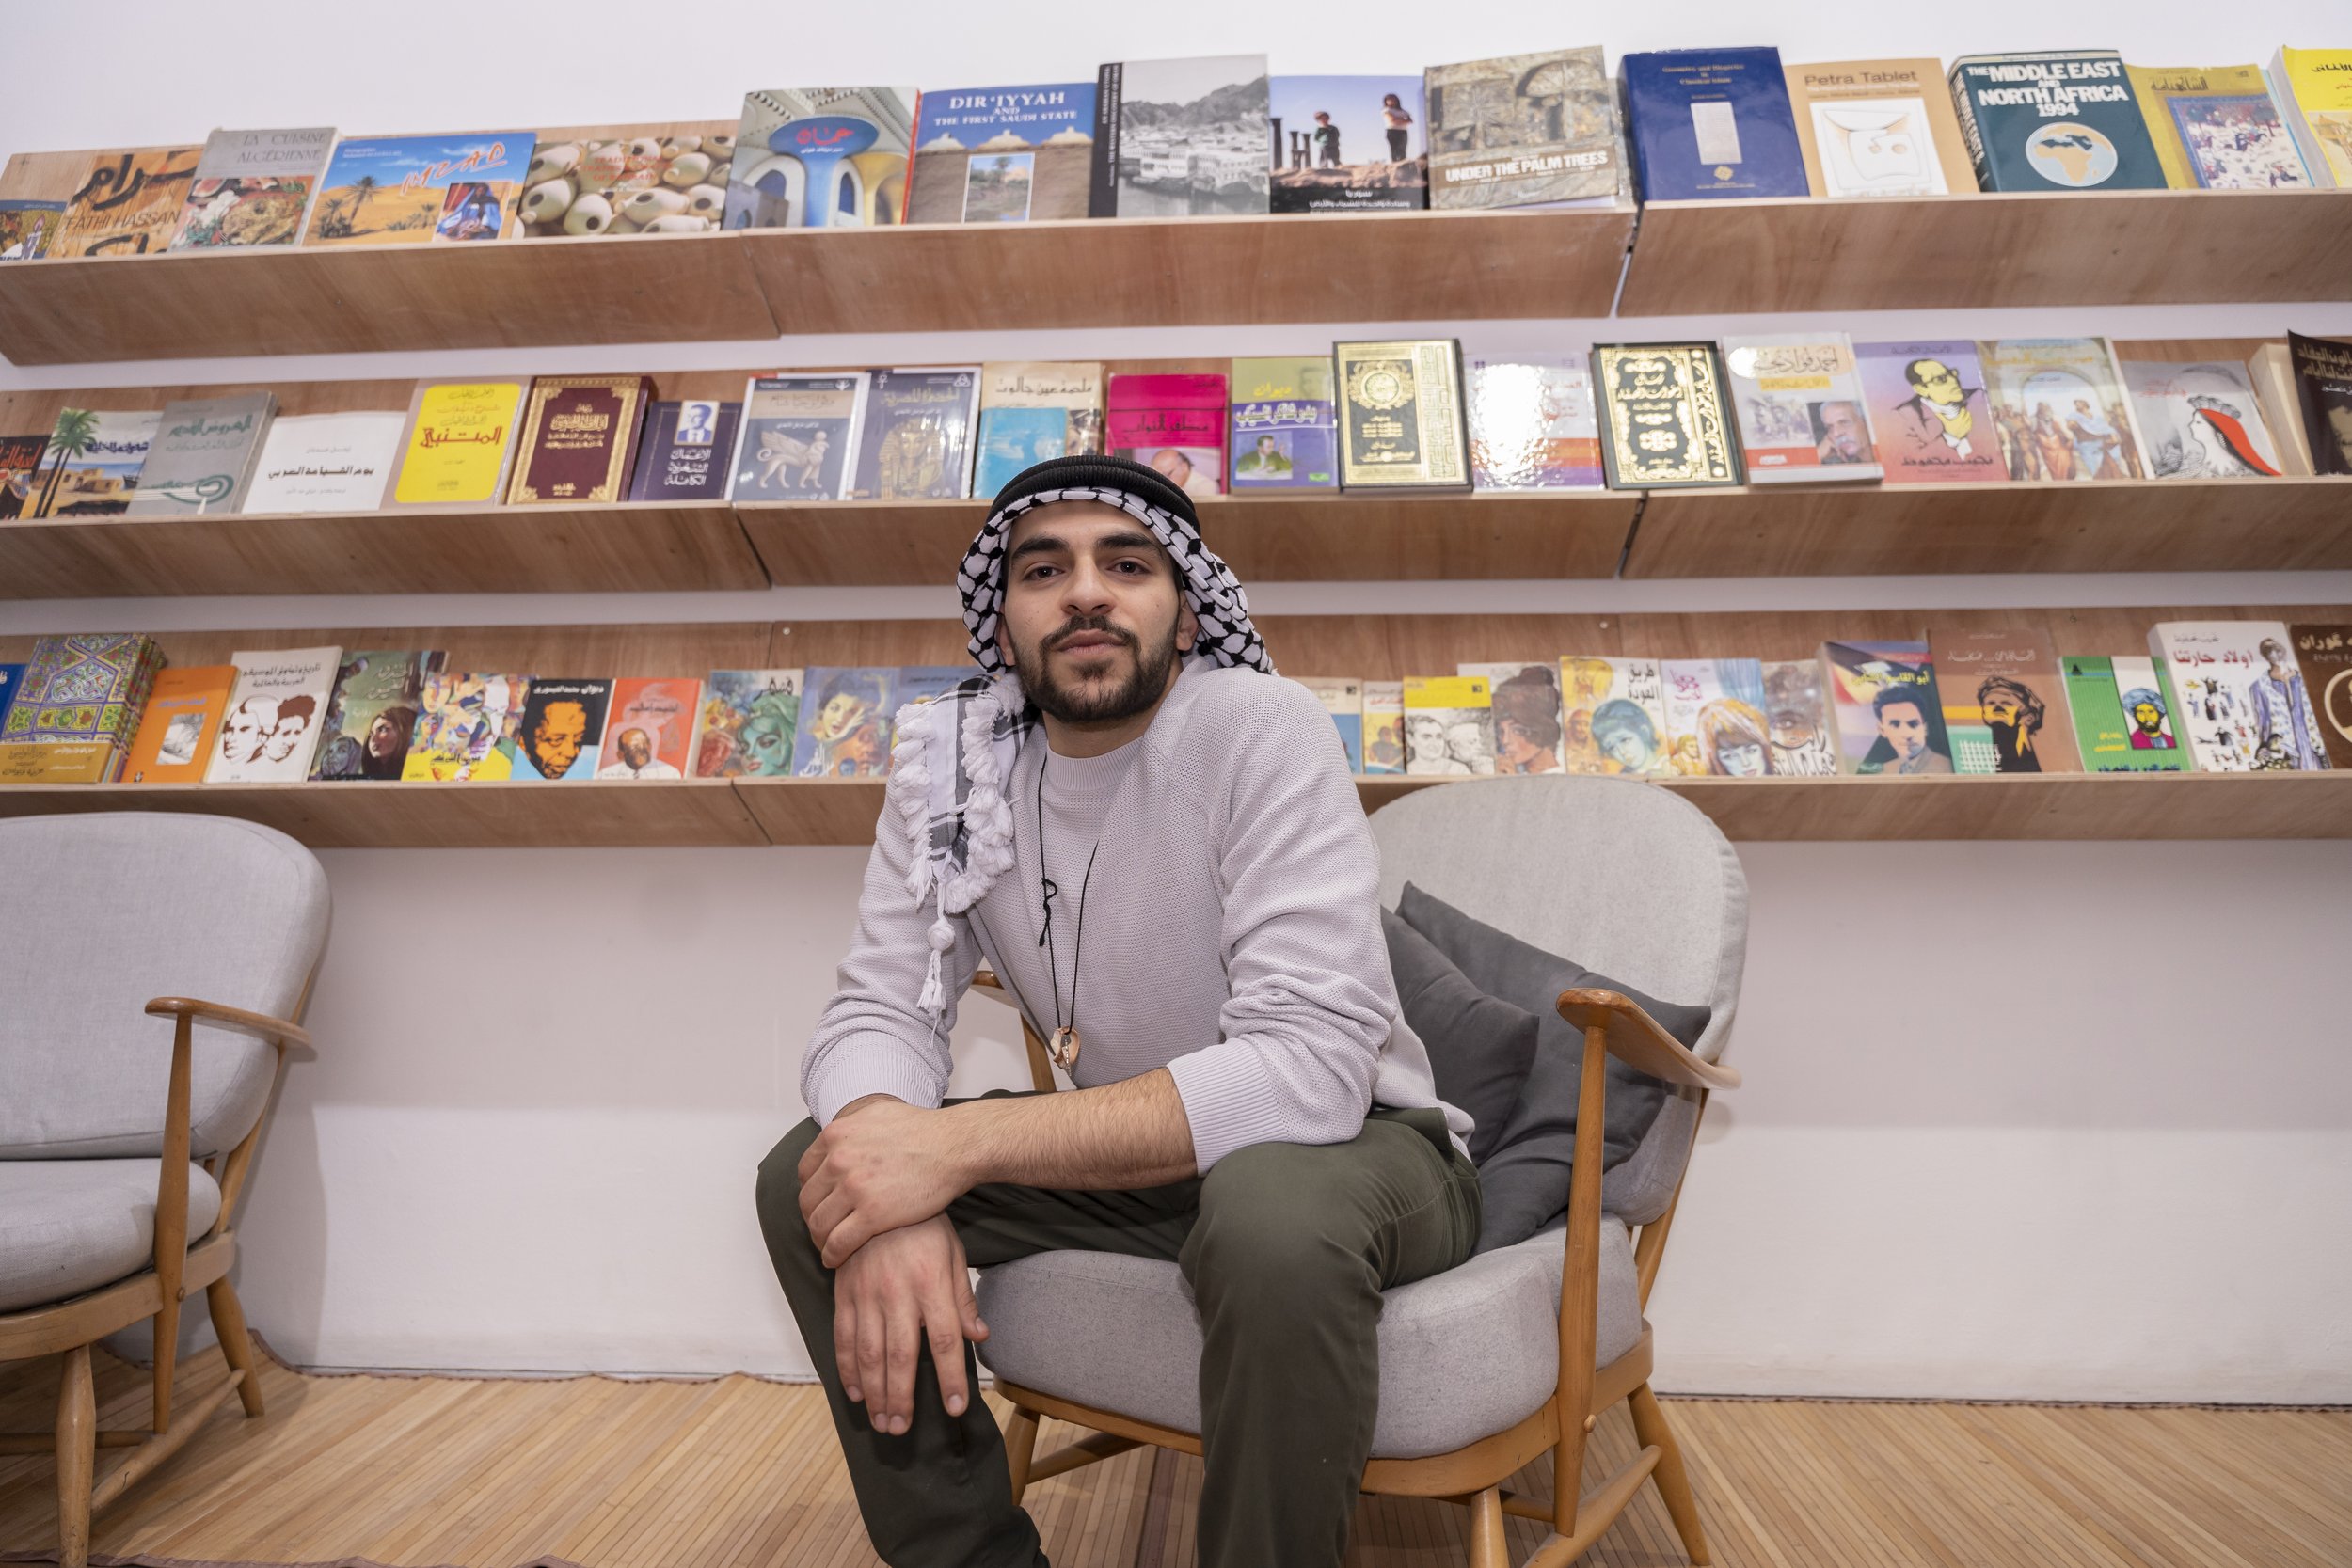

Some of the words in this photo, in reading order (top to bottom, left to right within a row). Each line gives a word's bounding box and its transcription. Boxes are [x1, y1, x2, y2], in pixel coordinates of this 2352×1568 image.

[1804, 72, 1855, 86] Petra
[1859, 70, 1919, 84] Tablet
[1967, 66, 1991, 76] THE
[1988, 62, 2069, 83] MIDDLE
[2068, 60, 2122, 79] EAST
[2037, 78, 2061, 88] AND
[1977, 87, 2051, 107] NORTH
[2052, 83, 2130, 103] AFRICA
[934, 117, 959, 127] THE
[962, 115, 995, 125] FIRST
[999, 112, 1037, 123] SAUDI
[1040, 110, 1078, 121] STATE
[993, 106, 1021, 116] AND
[2036, 102, 2080, 117] 1994
[243, 134, 260, 146] LA
[271, 131, 327, 145] CUISINE
[400, 142, 507, 196] IMZAD
[1445, 164, 1493, 182] UNDER
[1493, 161, 1520, 177] THE
[1520, 155, 1564, 173] PALM
[1563, 150, 1609, 168] TREES
[65, 215, 111, 230] FATHI
[114, 209, 181, 229] HASSAN
[1253, 380, 1293, 399] ديوان
[420, 425, 503, 450] المتنبي
[268, 466, 305, 480] العربي
[353, 466, 376, 477] يوم
[2172, 649, 2216, 668] حارتنا
[1628, 662, 1656, 684] طريق
[1886, 671, 1917, 684] القاسم
[1915, 669, 1930, 686] أبو
[1627, 683, 1660, 706] العودة
